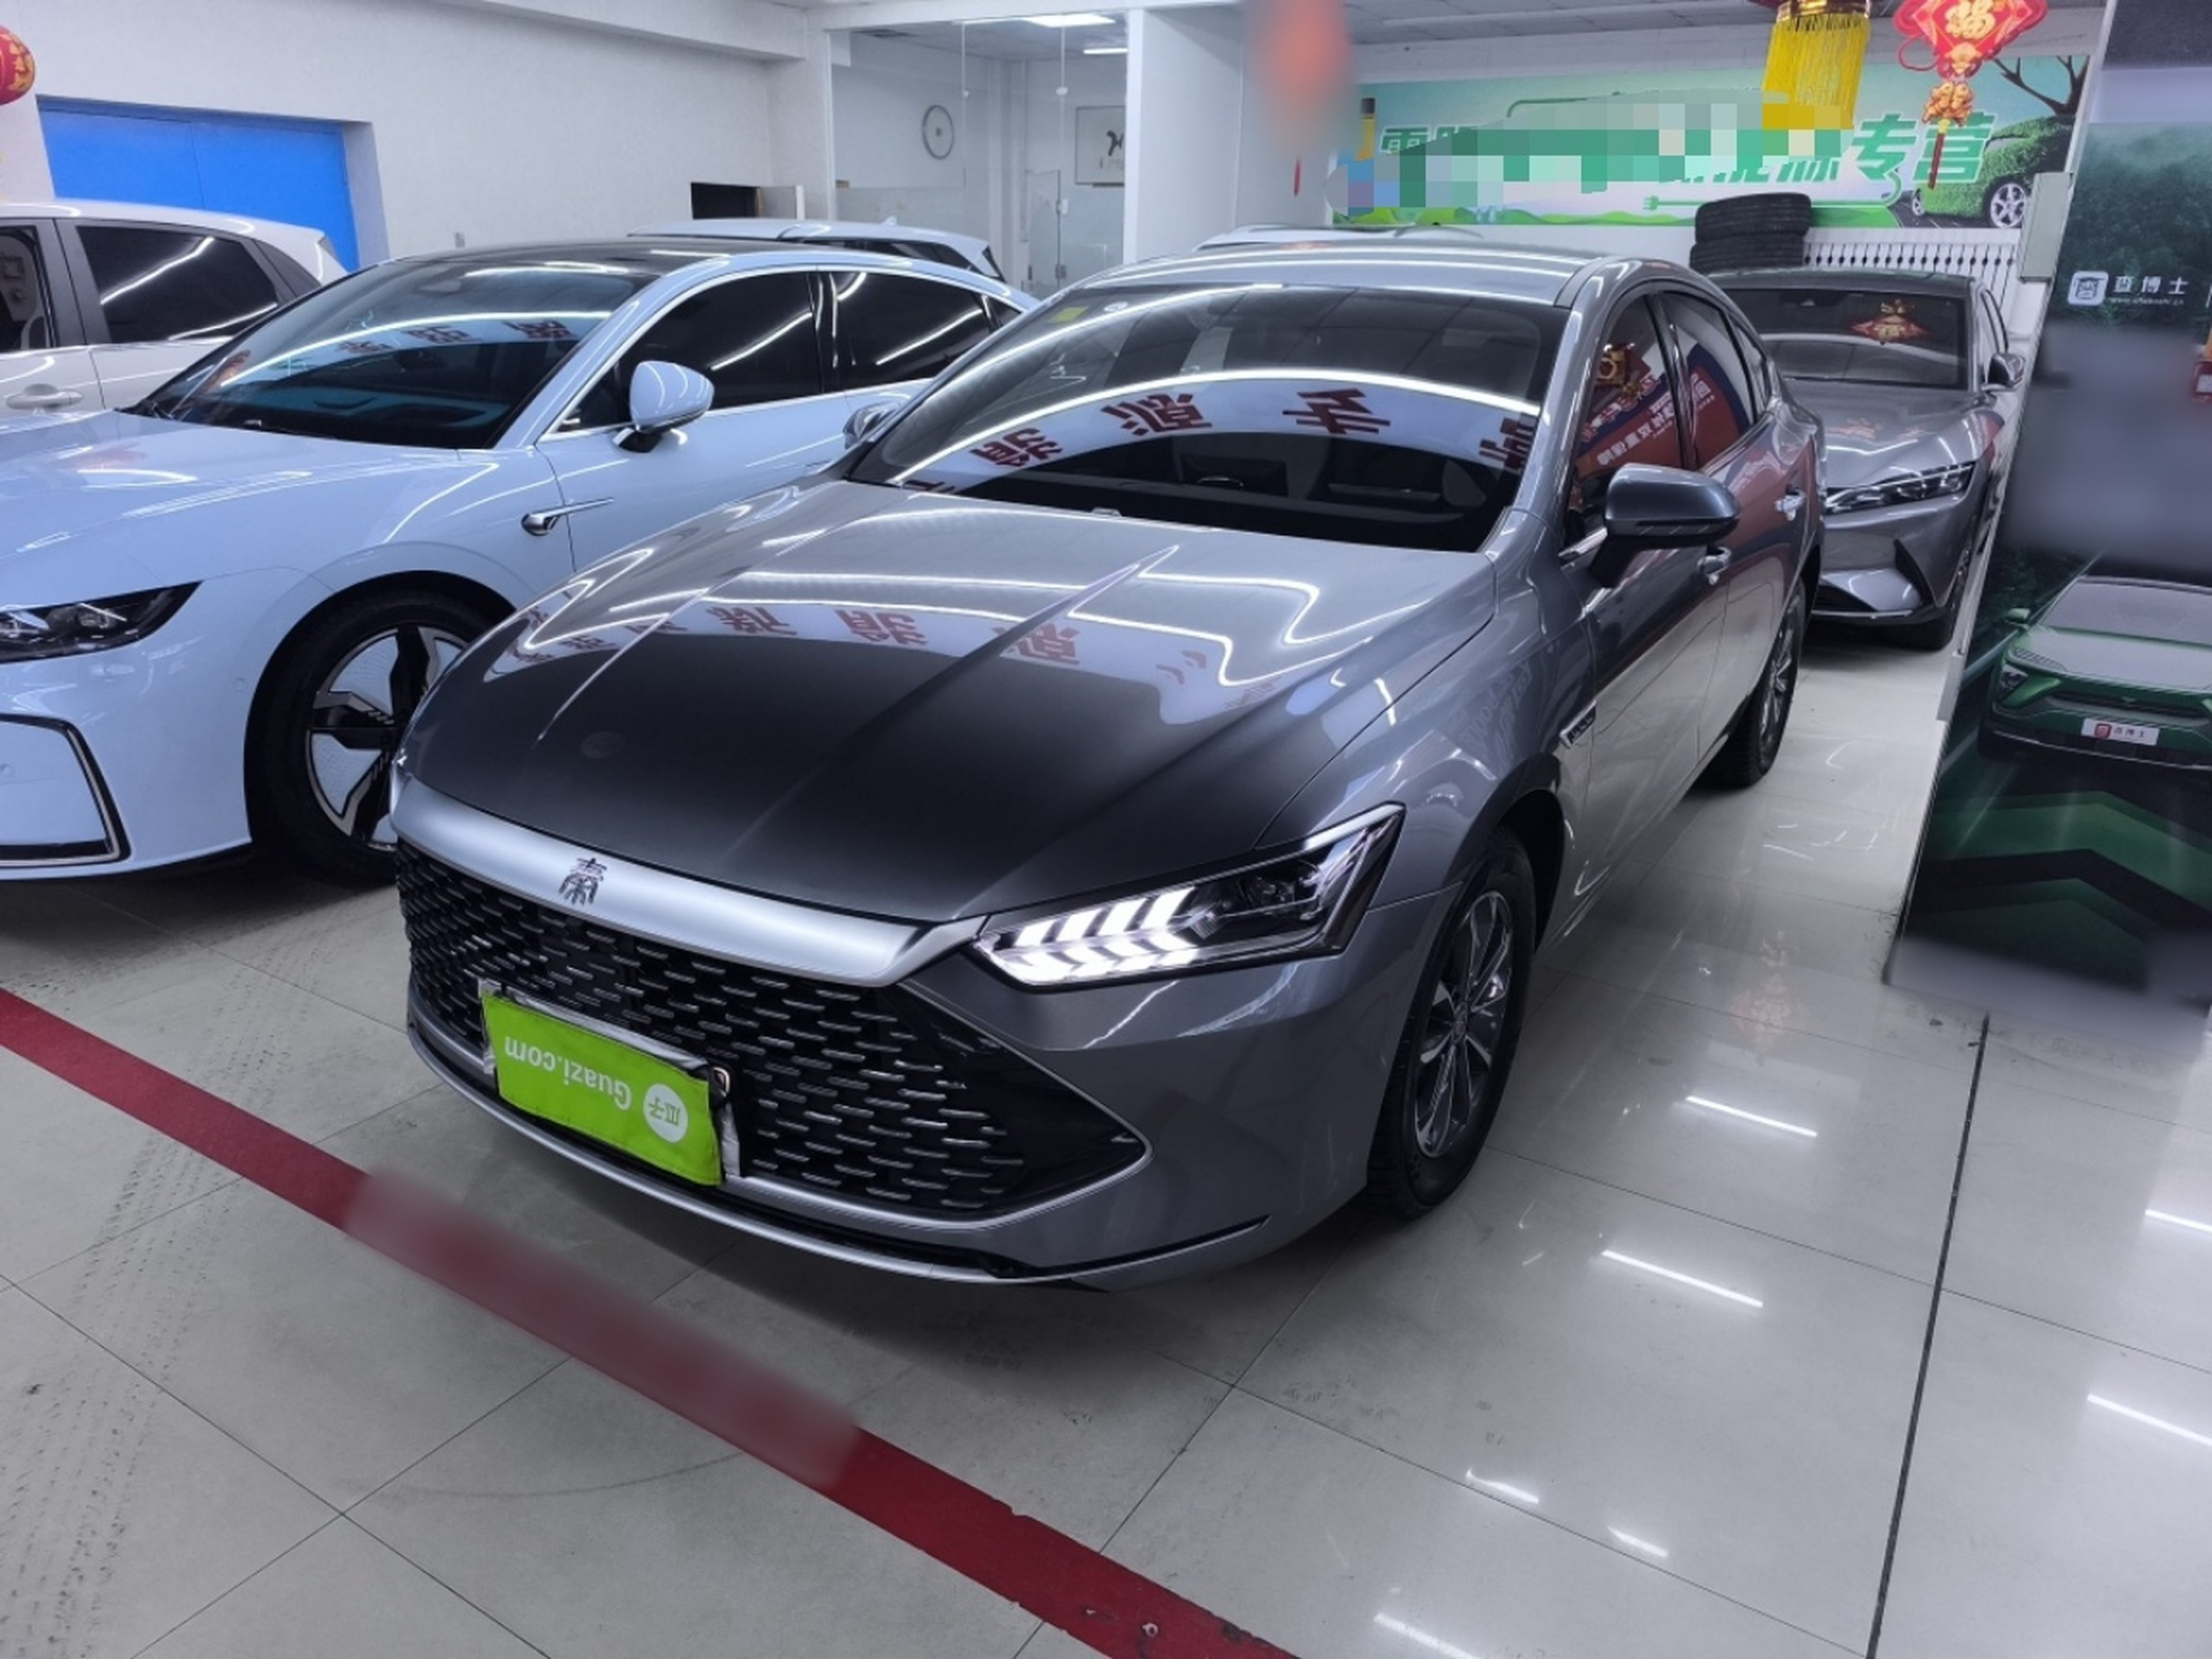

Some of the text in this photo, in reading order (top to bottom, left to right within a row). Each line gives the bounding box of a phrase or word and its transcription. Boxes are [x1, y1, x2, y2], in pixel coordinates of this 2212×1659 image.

[2113, 275, 2189, 295] 查博士
[504, 1035, 632, 1112] Guazi.com
